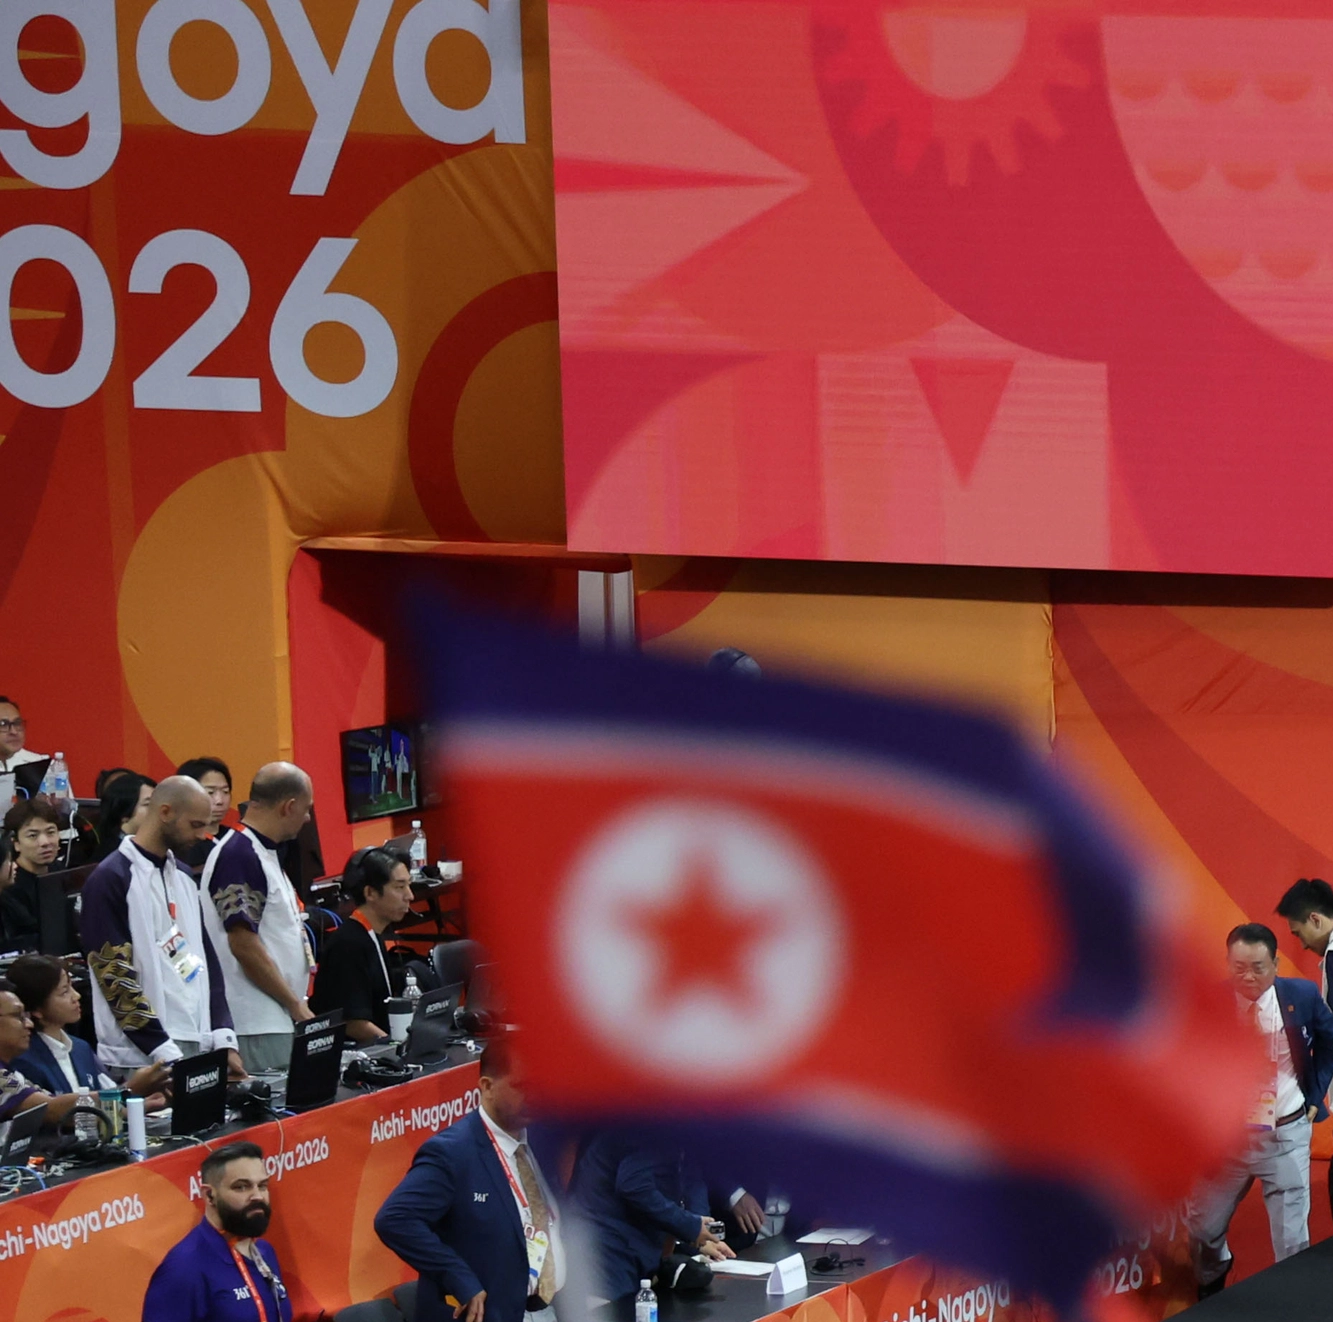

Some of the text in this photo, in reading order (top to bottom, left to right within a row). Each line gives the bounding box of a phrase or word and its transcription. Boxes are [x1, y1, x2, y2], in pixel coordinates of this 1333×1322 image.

[0, 224, 398, 418] 026
[370, 1097, 463, 1144] Aichi-Nagoya
[295, 1135, 330, 1170] 2026
[100, 1193, 145, 1229] 2026
